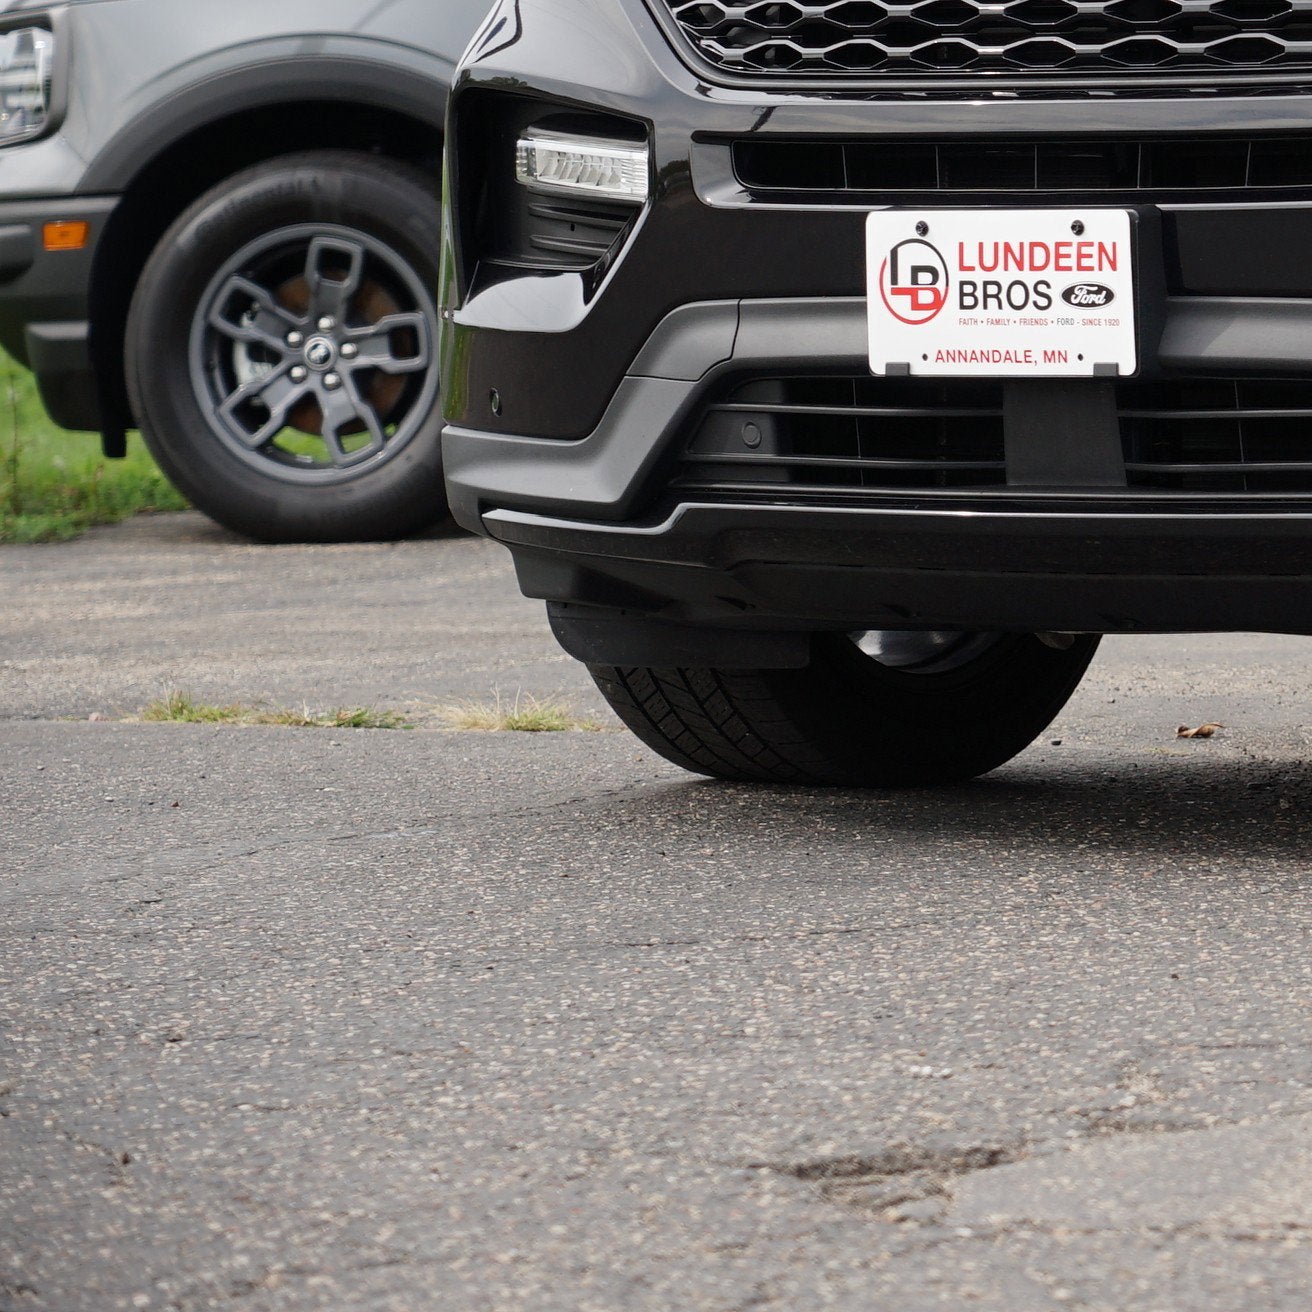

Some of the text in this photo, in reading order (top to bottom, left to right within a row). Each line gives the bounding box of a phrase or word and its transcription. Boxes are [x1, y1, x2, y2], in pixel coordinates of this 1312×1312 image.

[958, 241, 1118, 272] LUNDEEN
[959, 279, 1053, 311] BROS
[1070, 285, 1106, 306] Ford
[958, 318, 1120, 327] FAITH FAMILY FRIENDS FORD SINCE 1920
[935, 349, 1068, 367] ANNANDALE, MN
